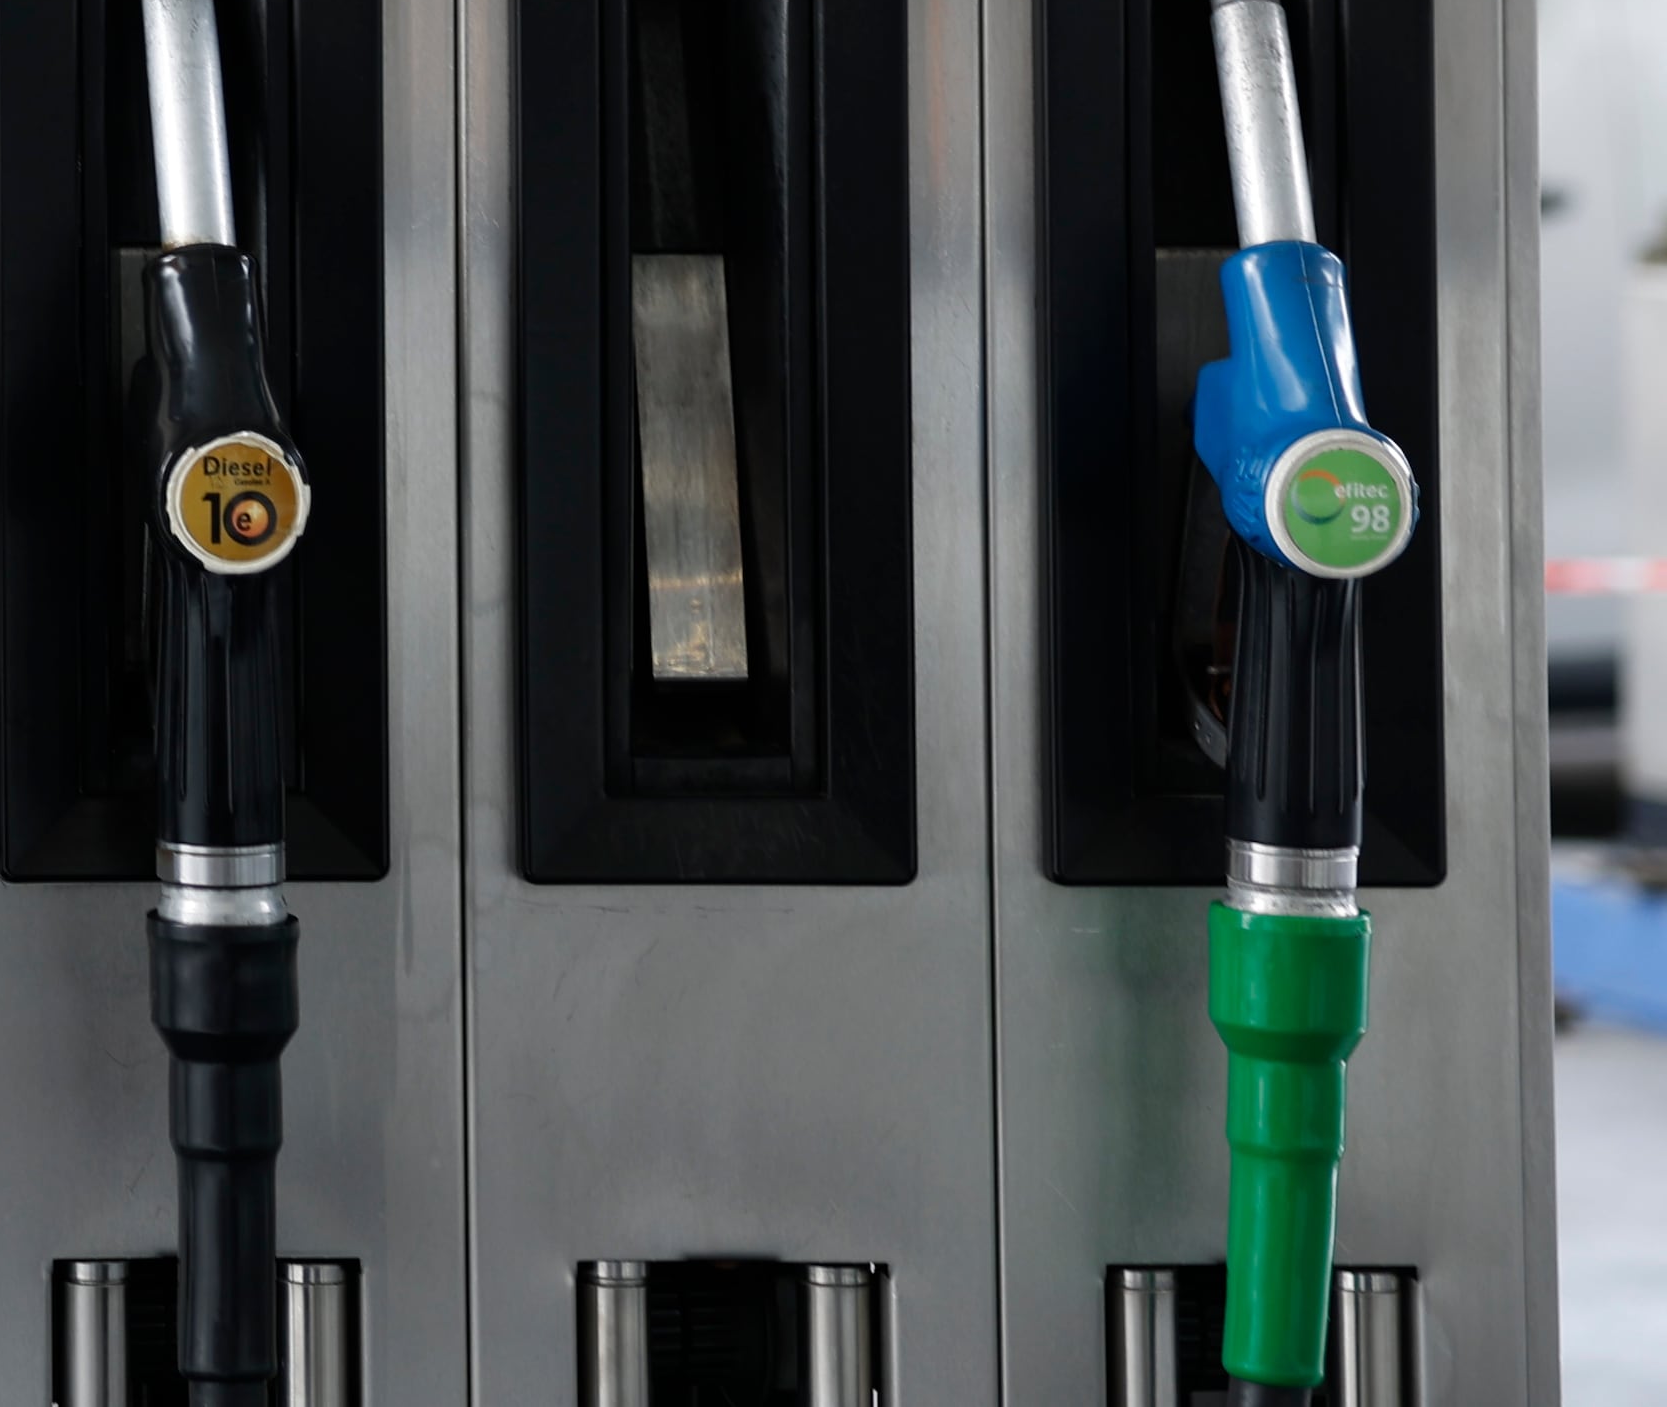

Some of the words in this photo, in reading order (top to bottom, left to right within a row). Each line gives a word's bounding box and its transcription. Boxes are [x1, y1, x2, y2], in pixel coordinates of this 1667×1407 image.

[203, 455, 272, 477] Diesel
[1334, 483, 1389, 499] efitec
[1350, 504, 1391, 534] 98
